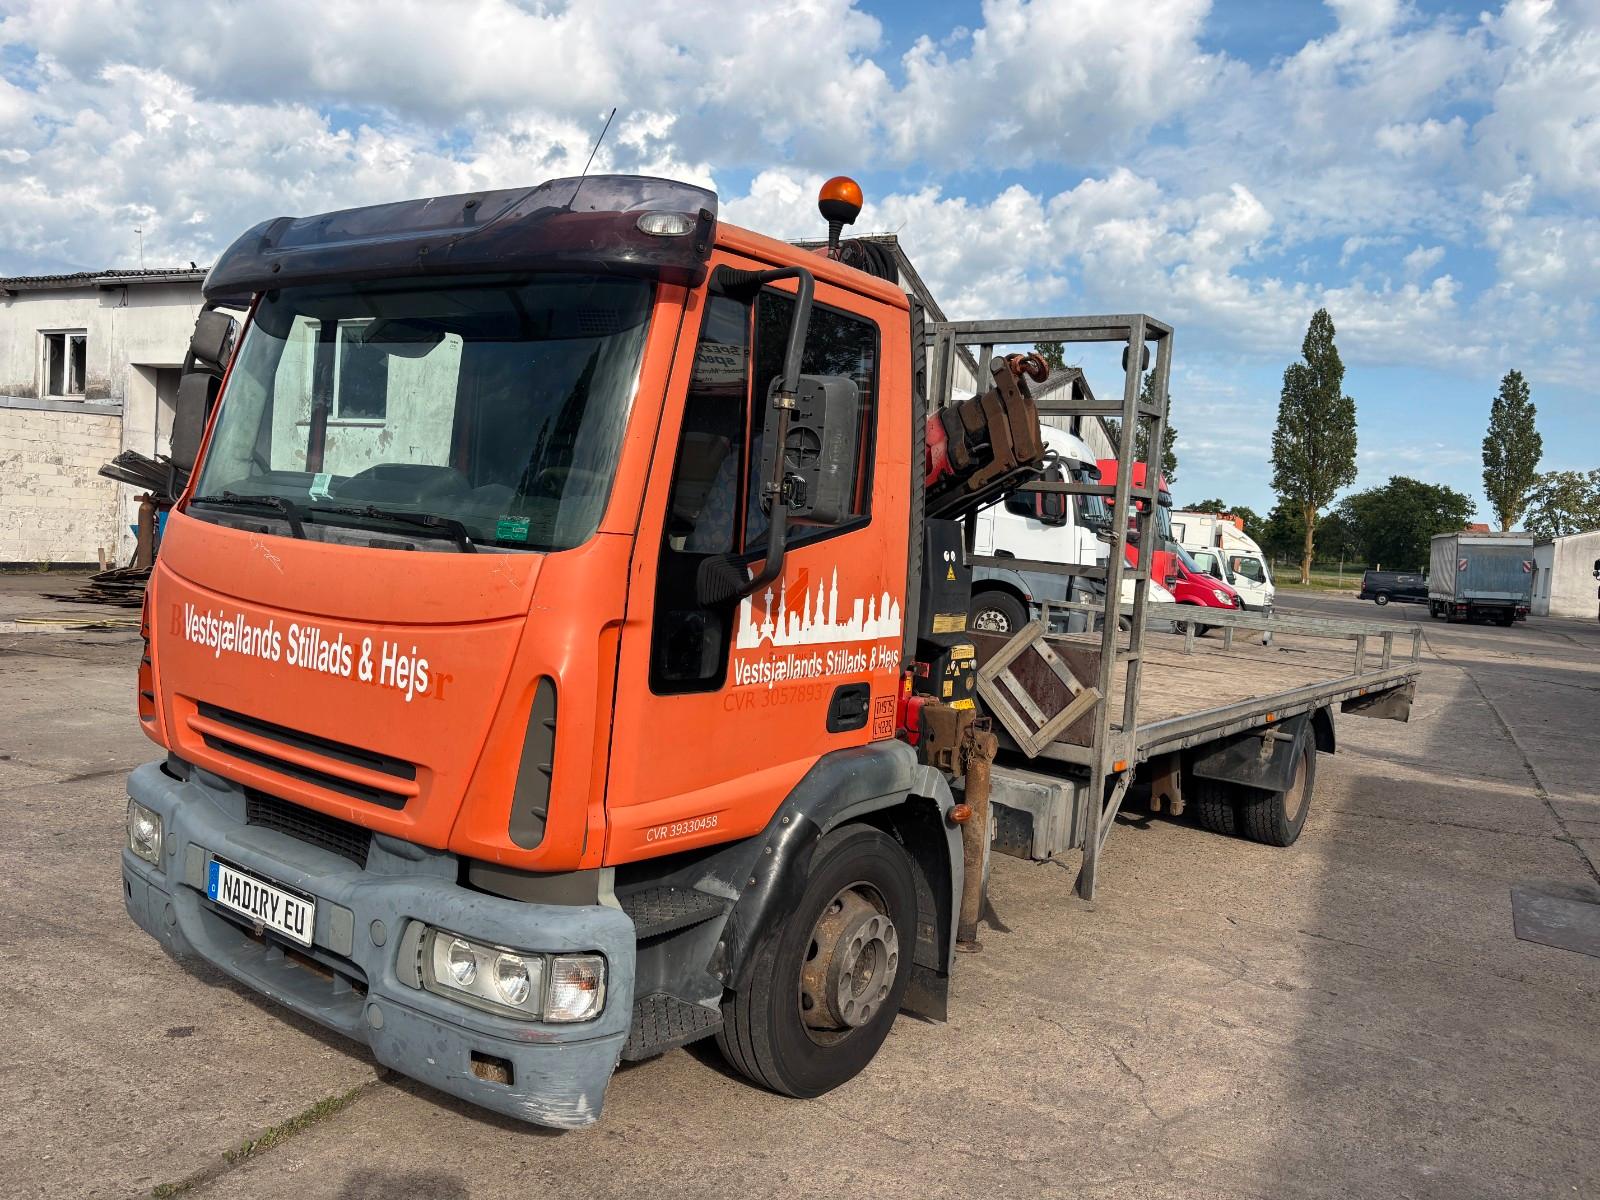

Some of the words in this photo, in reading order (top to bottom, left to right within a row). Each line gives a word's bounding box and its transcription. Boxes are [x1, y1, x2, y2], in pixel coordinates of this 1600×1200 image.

[184, 602, 281, 661] Vestsjællands
[286, 623, 352, 677] Stillads
[358, 637, 373, 681] &
[379, 640, 429, 702] Hejs
[734, 651, 822, 689] Vestsjællands
[826, 648, 867, 676] Stillads
[868, 646, 877, 671] &
[723, 691, 756, 712] CVR
[646, 826, 668, 842] CVR
[669, 815, 718, 837] 39330458
[223, 872, 305, 935] NADIRY.EU
